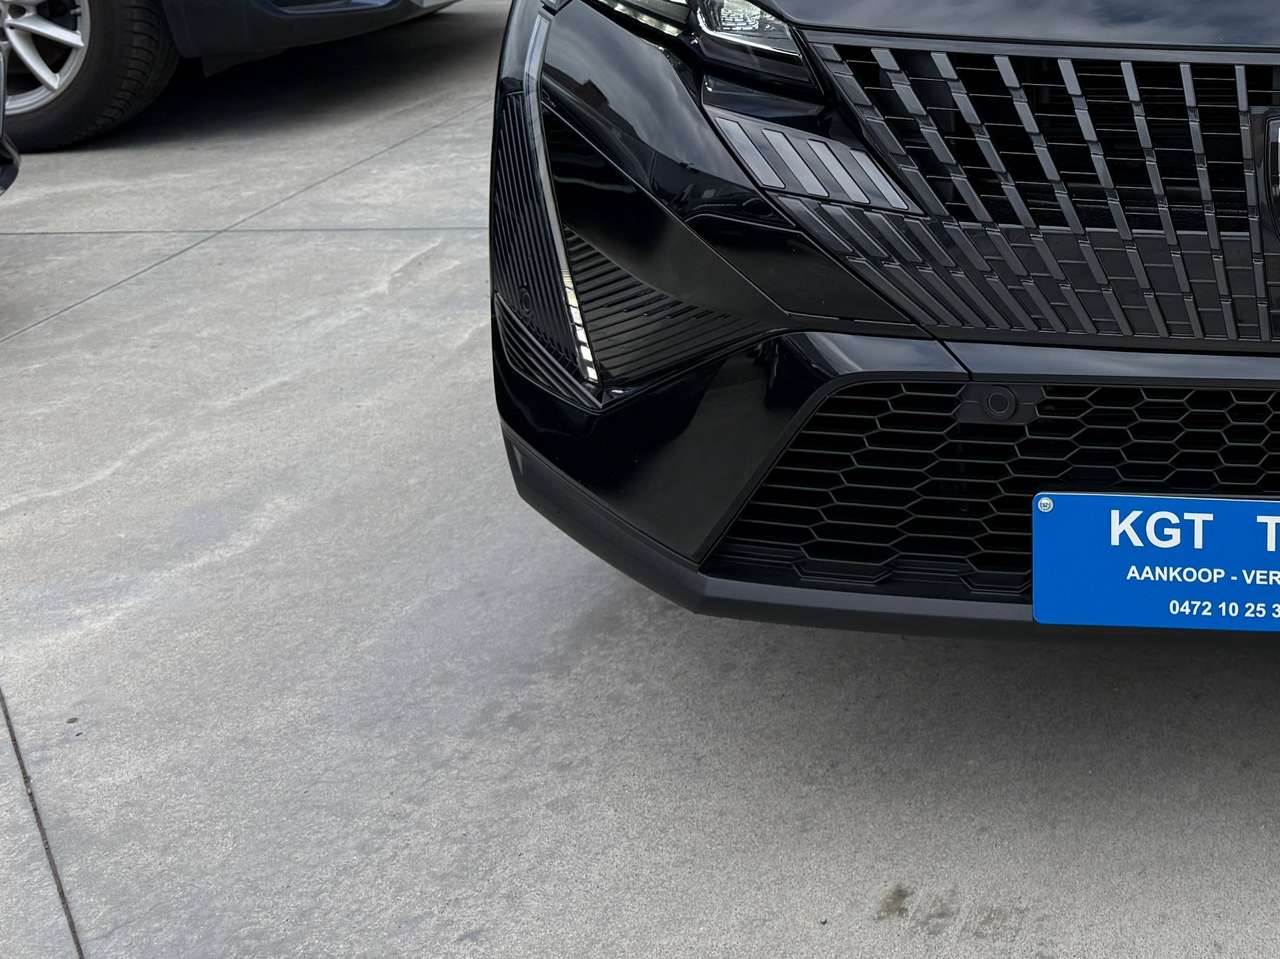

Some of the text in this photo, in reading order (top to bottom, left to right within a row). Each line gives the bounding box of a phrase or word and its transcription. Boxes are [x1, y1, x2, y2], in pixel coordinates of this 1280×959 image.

[1110, 509, 1214, 549] KGT
[1126, 565, 1225, 583] AANKOOP
[1169, 599, 1212, 616] 0472
[1218, 601, 1239, 617] 10
[1244, 602, 1266, 618] 25
